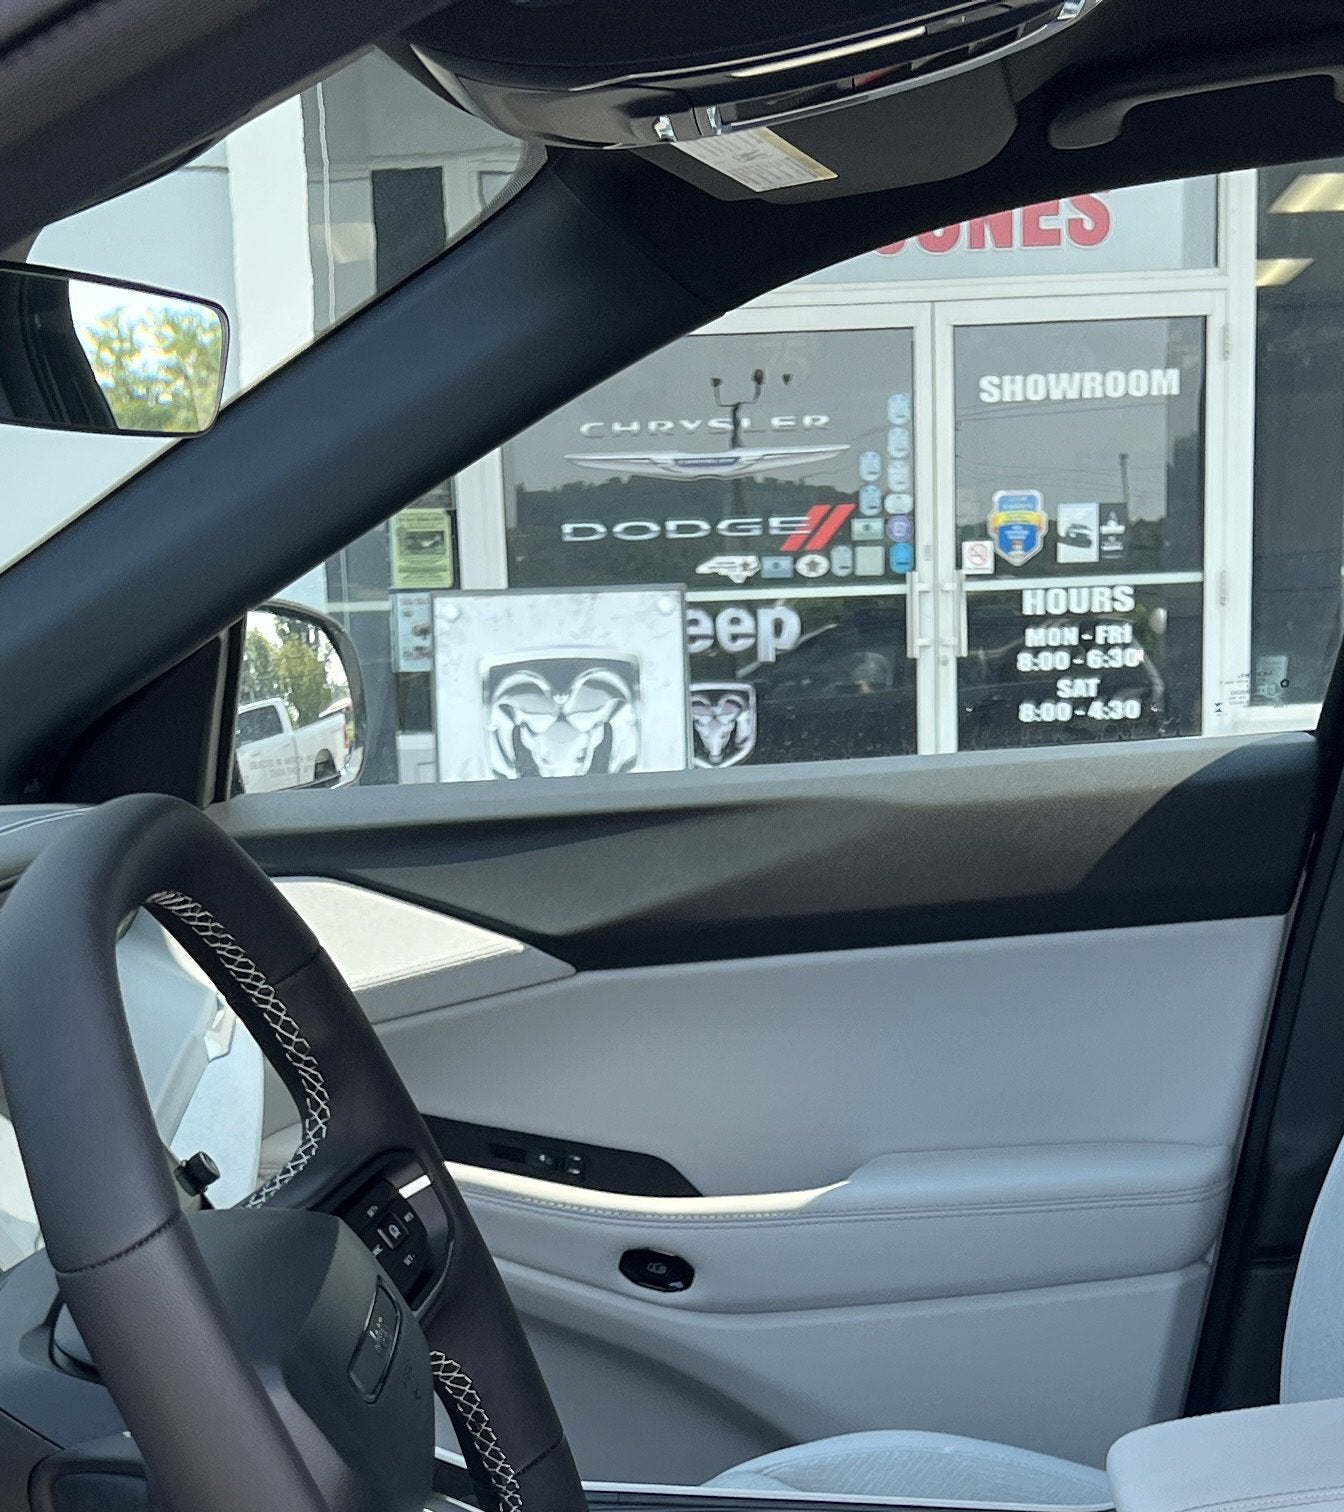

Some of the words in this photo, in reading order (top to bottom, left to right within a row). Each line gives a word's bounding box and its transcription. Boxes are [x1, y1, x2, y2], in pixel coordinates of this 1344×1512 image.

[875, 194, 1112, 254] NES
[979, 367, 1181, 403] SHOWROOM
[579, 414, 831, 438] CHRYSLER
[561, 515, 812, 542] DODGE
[1021, 585, 1136, 616] HOURS
[686, 606, 802, 663] eep
[1024, 625, 1080, 648] MON
[1094, 622, 1133, 645] FRI
[1016, 650, 1071, 672] 8:00
[1086, 647, 1143, 669] 6:30
[1056, 677, 1102, 699] SAT
[1018, 702, 1073, 723] 8:00
[1087, 699, 1142, 720] 4:30
